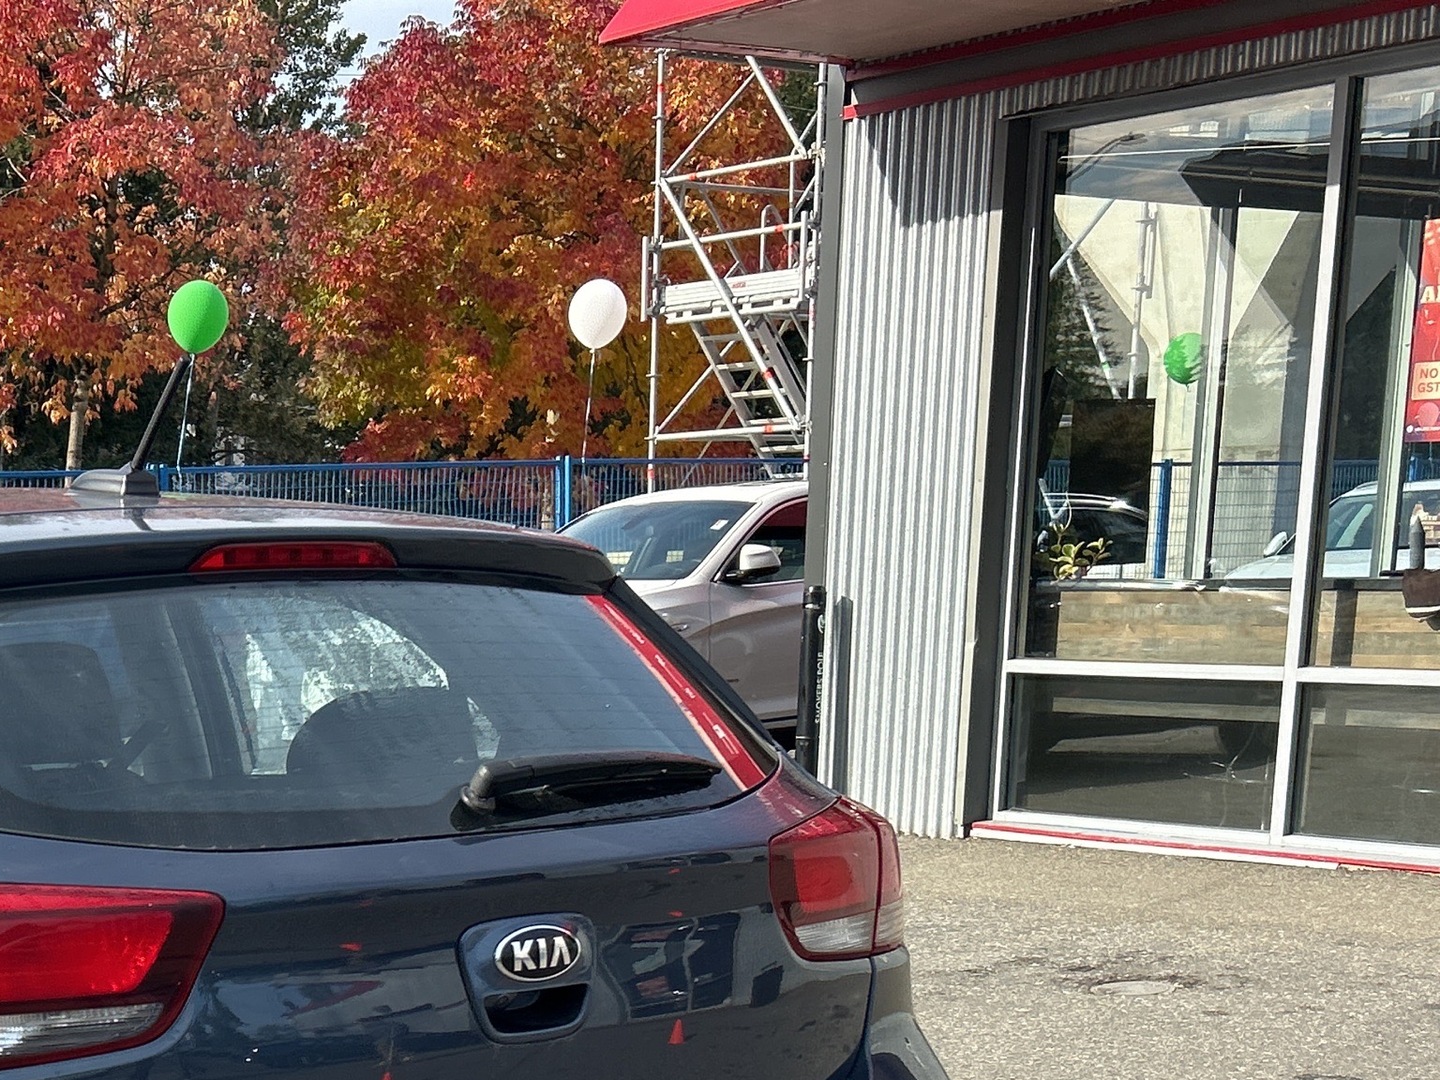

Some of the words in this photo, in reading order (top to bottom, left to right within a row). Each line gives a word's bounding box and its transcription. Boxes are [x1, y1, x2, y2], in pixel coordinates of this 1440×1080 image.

[1420, 367, 1439, 379] NO
[1417, 382, 1440, 393] GST
[511, 936, 571, 972] KIA
